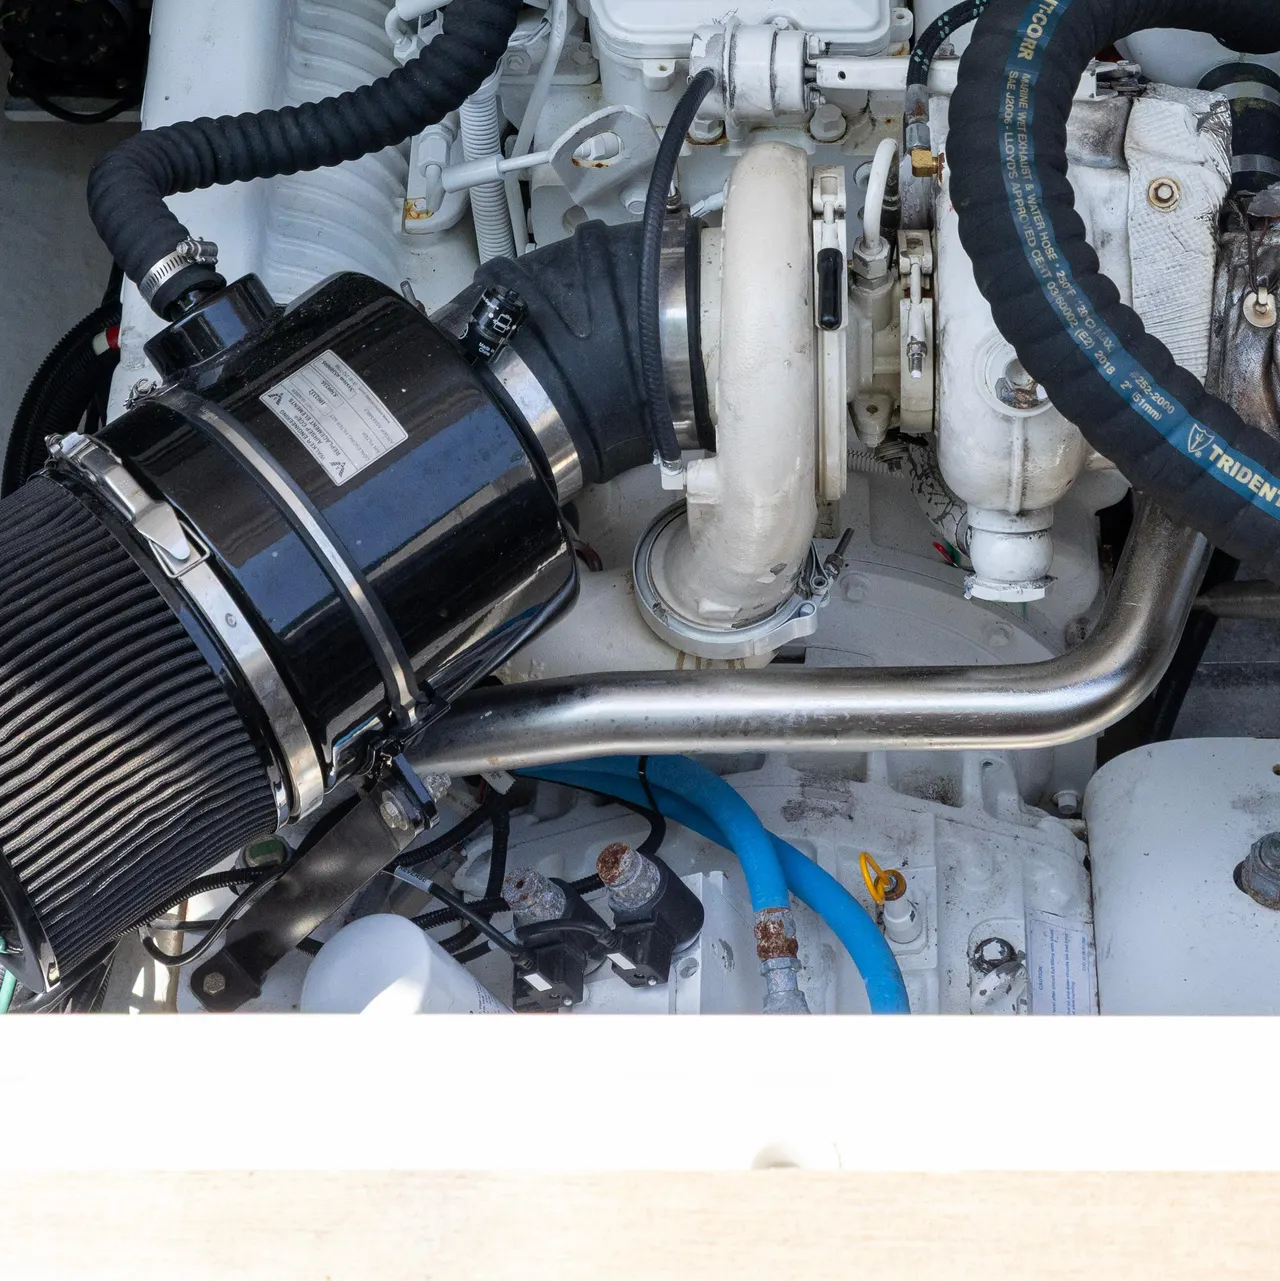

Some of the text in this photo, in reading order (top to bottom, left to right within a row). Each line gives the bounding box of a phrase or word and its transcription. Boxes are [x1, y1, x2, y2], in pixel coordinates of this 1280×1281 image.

[1006, 70, 1017, 89] SAE
[1018, 72, 1031, 108] MARINE
[1003, 91, 1014, 124] J2006
[1016, 111, 1027, 132] WET
[1004, 131, 1018, 179] LLOYD'S
[1016, 132, 1031, 180] EXHAUST
[1024, 182, 1034, 192] &
[1009, 182, 1037, 247] APPROVED
[1025, 192, 1047, 230] WATER
[1037, 231, 1058, 261] HOSE
[1029, 247, 1054, 281] CERT
[1072, 326, 1096, 350] (E2)
[1092, 349, 1116, 375] 2018
[1129, 390, 1164, 422] (51mm)
[278, 408, 326, 461] WALKER ENGINEERING
[287, 396, 341, 456] REPLACEMENT ELEMENTS
[304, 425, 323, 445] AIRSEP
